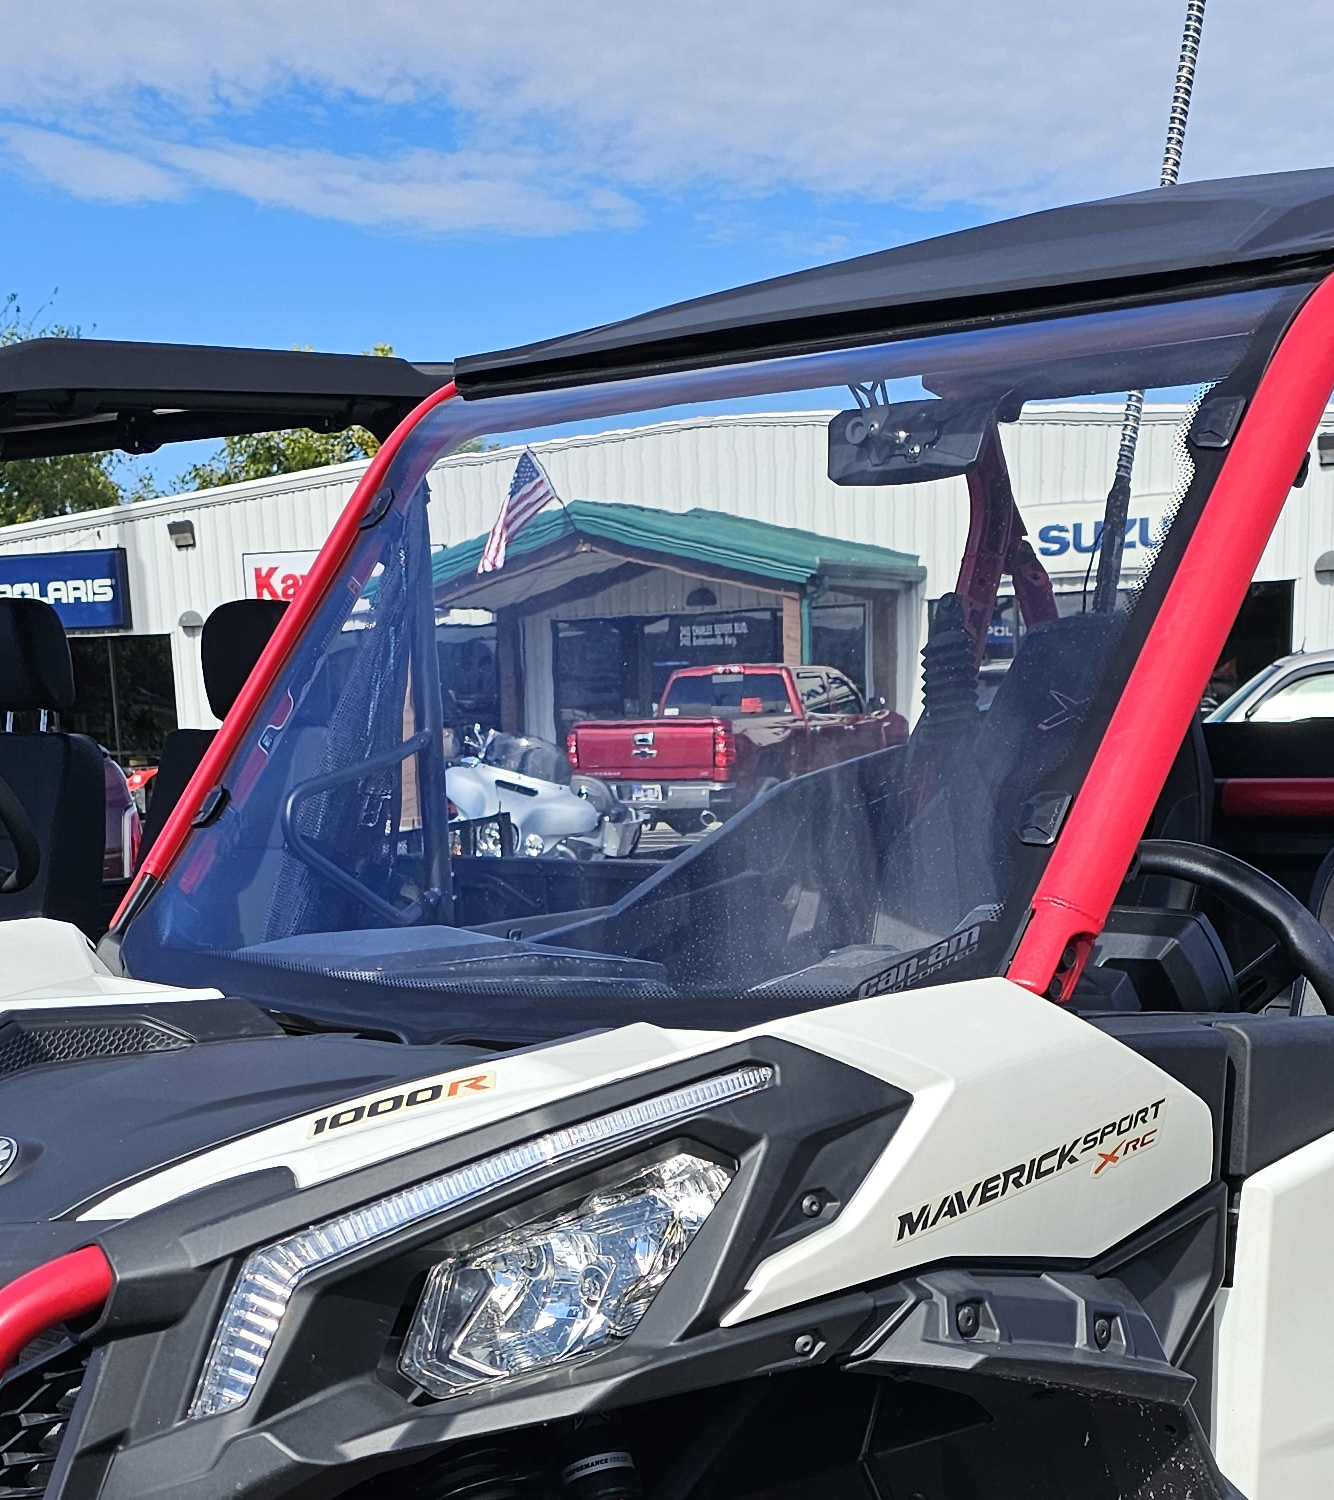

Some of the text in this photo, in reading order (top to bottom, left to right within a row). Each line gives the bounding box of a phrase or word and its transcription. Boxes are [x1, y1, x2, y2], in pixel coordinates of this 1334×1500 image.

[858, 925, 980, 999] can-am
[313, 1075, 490, 1136] 1000R
[896, 1098, 1166, 1241] MAVERICK SPORT
[1094, 1128, 1158, 1174] XRC
